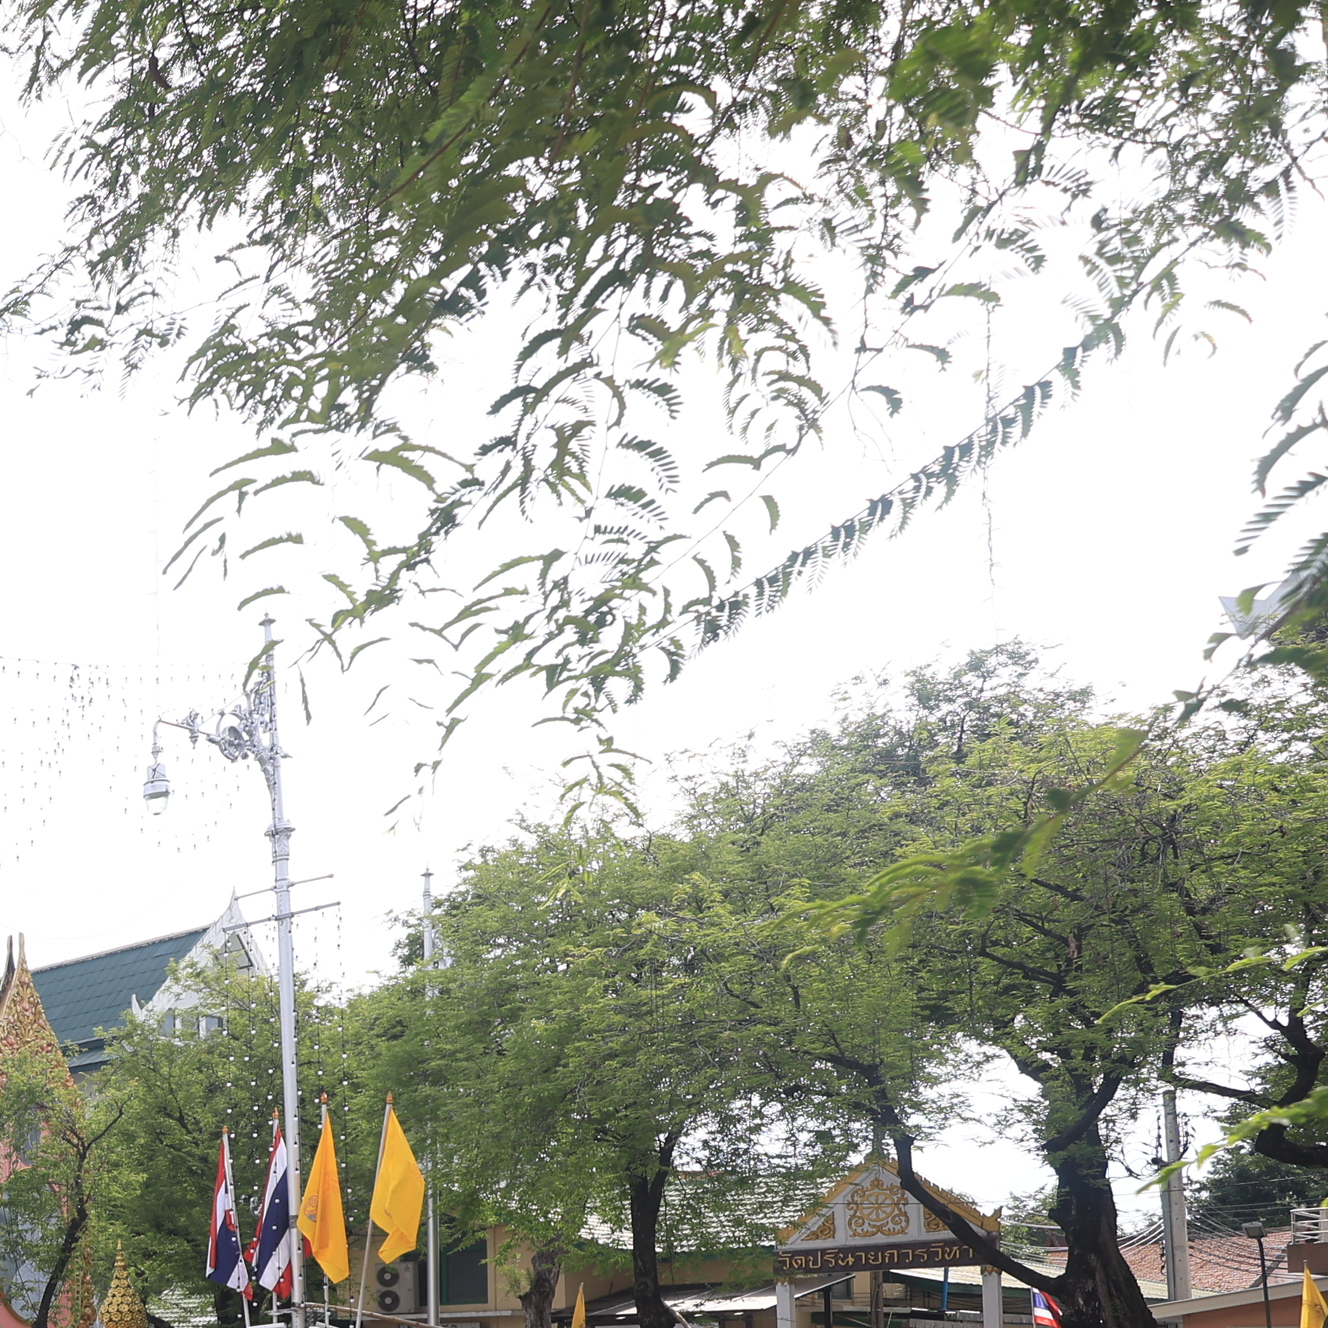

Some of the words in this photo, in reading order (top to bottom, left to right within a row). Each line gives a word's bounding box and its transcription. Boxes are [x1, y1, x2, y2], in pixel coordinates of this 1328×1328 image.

[778, 1243, 974, 1270] วัดปรินายกวรวิหา
